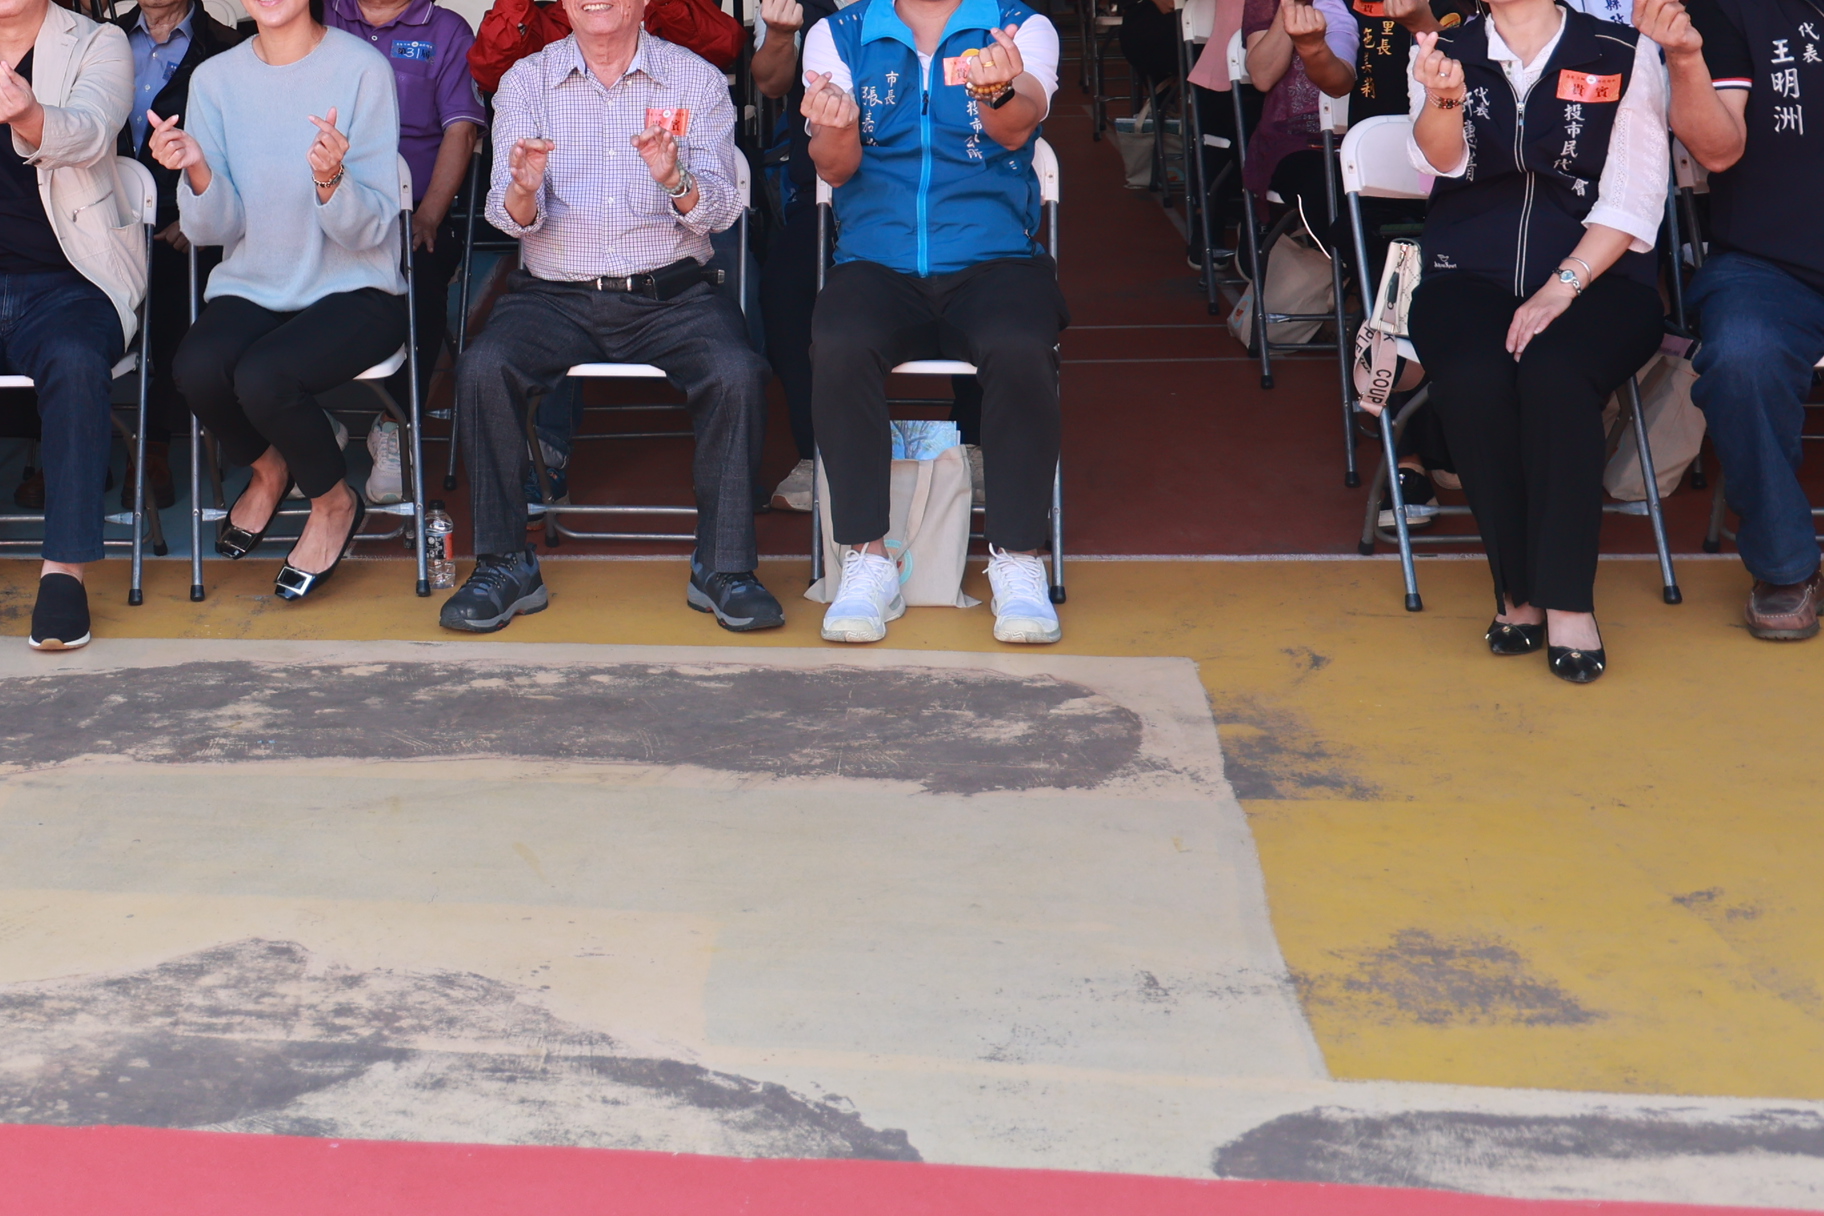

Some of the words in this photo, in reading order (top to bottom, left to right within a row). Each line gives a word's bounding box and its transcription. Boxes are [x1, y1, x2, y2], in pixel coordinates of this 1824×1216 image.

[1376, 20, 1395, 56] 里長
[1798, 22, 1823, 63] 代表
[884, 71, 899, 105] 市長
[1473, 87, 1491, 120] 代表
[1770, 38, 1804, 136] 王明洲
[964, 89, 983, 160] 投市公所
[1553, 103, 1590, 197] 投市民代會
